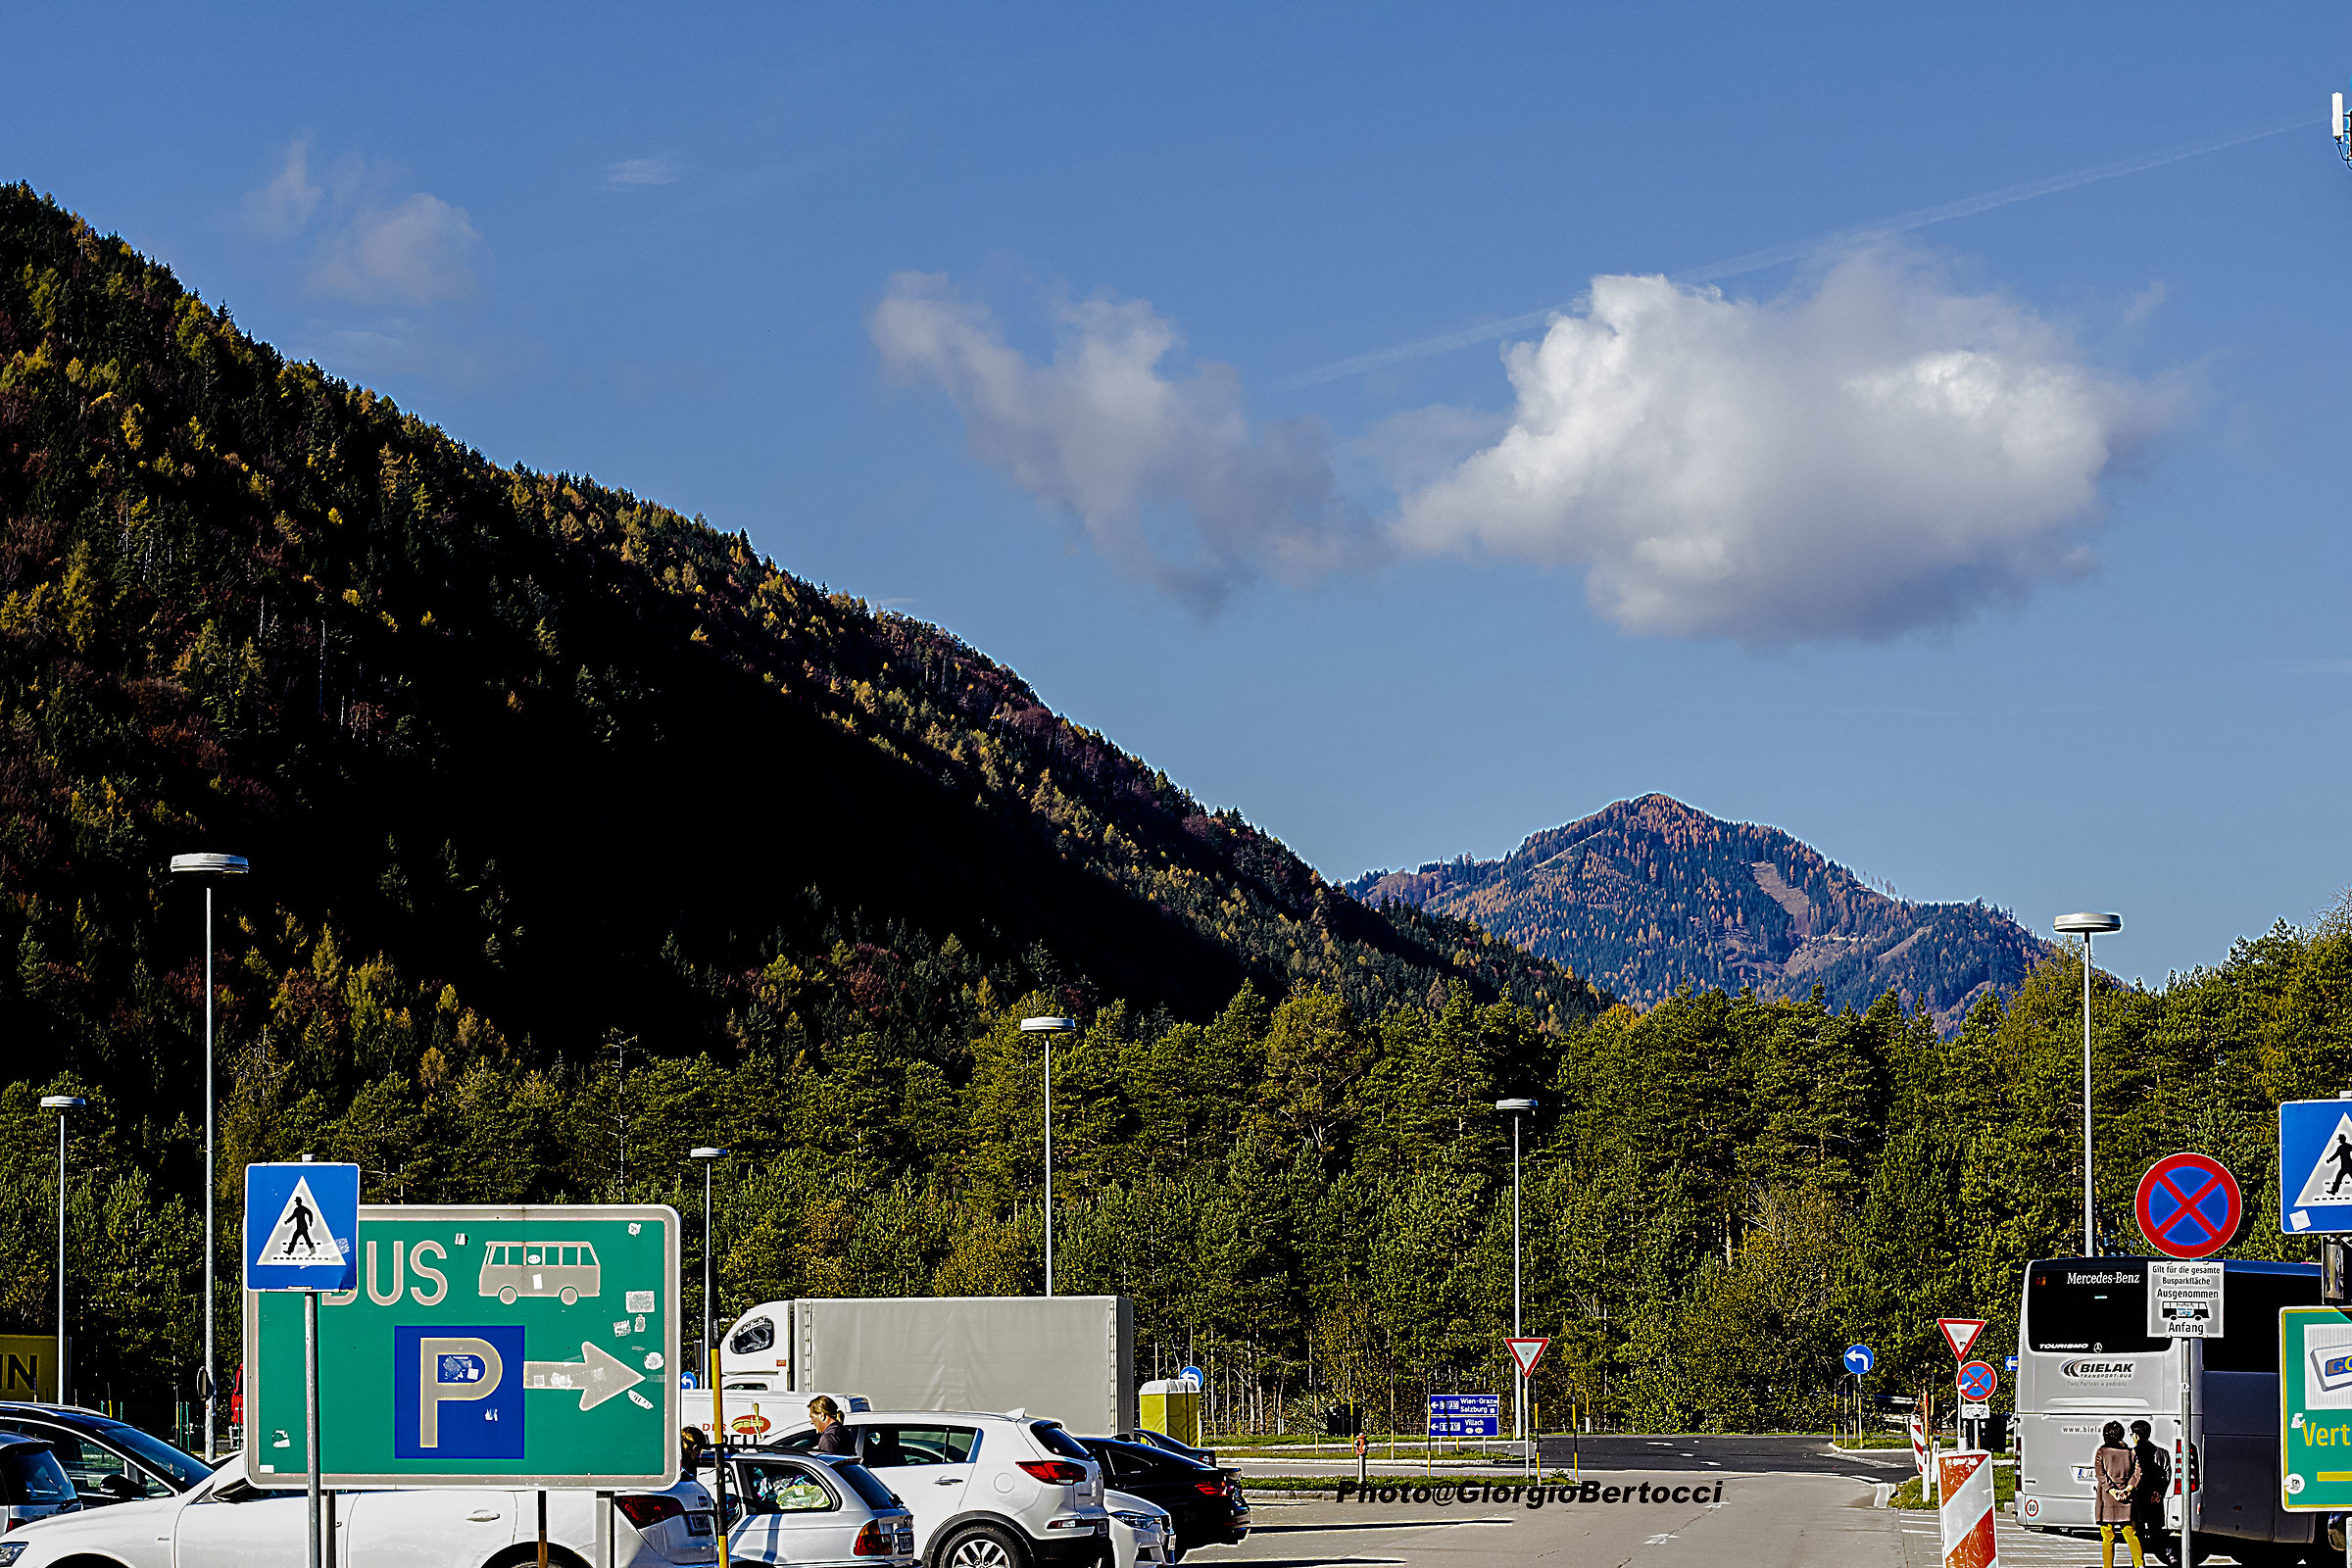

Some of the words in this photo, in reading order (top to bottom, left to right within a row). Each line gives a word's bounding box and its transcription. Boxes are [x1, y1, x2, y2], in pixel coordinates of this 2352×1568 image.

[322, 1241, 448, 1306] US
[2179, 1265, 2189, 1274] die
[2190, 1266, 2221, 1275] gesamte
[2067, 1272, 2140, 1285] Mercedes-Benz
[2162, 1277, 2211, 1286] Busparkfläche
[2156, 1288, 2219, 1299] Ausgenommen
[2168, 1322, 2204, 1335] Anfang
[2080, 1363, 2134, 1373] BIELAK
[420, 1338, 503, 1447] P
[2029, 1503, 2036, 1512] 80
